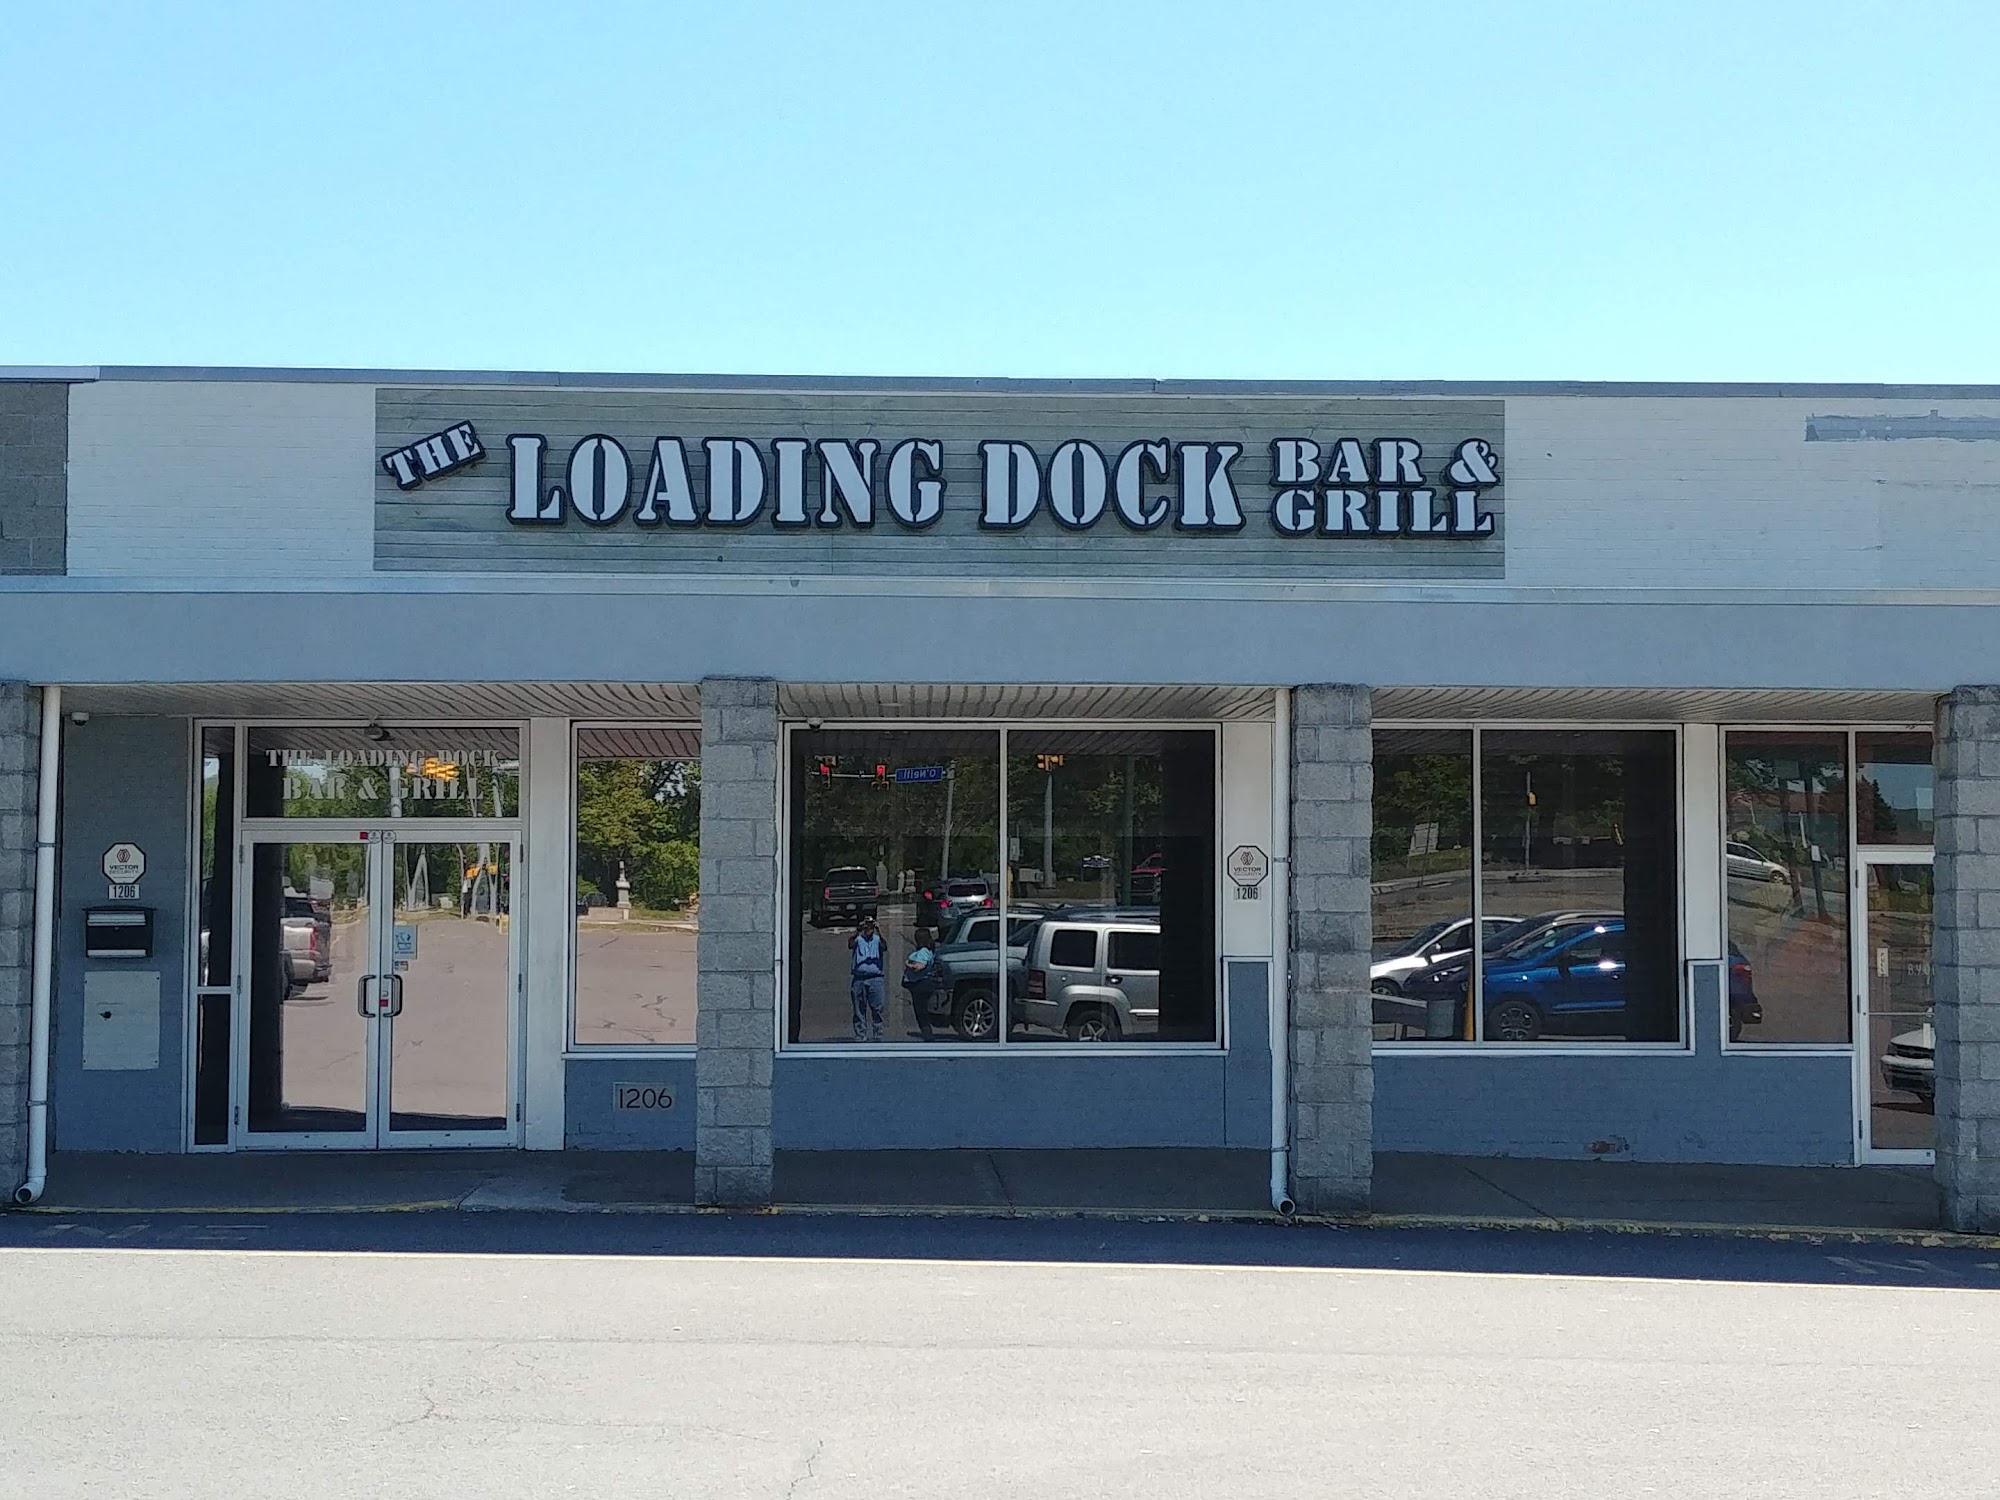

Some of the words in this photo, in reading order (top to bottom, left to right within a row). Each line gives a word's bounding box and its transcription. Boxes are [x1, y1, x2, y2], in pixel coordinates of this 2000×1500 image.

[382, 420, 486, 490] THE
[1270, 437, 1427, 487] BAR
[1447, 437, 1500, 487] &
[505, 433, 946, 529] LOADING
[978, 437, 1245, 531] DOCK
[1271, 486, 1494, 537] GRILL
[265, 749, 313, 767] THE
[324, 749, 425, 767] LOADING
[436, 749, 500, 767] DOCK
[282, 777, 346, 800] BAR
[358, 777, 380, 800] &
[395, 777, 484, 800] GRILL
[113, 885, 136, 898] 1206
[1236, 887, 1259, 900] 1206
[619, 1088, 673, 1109] 1206
